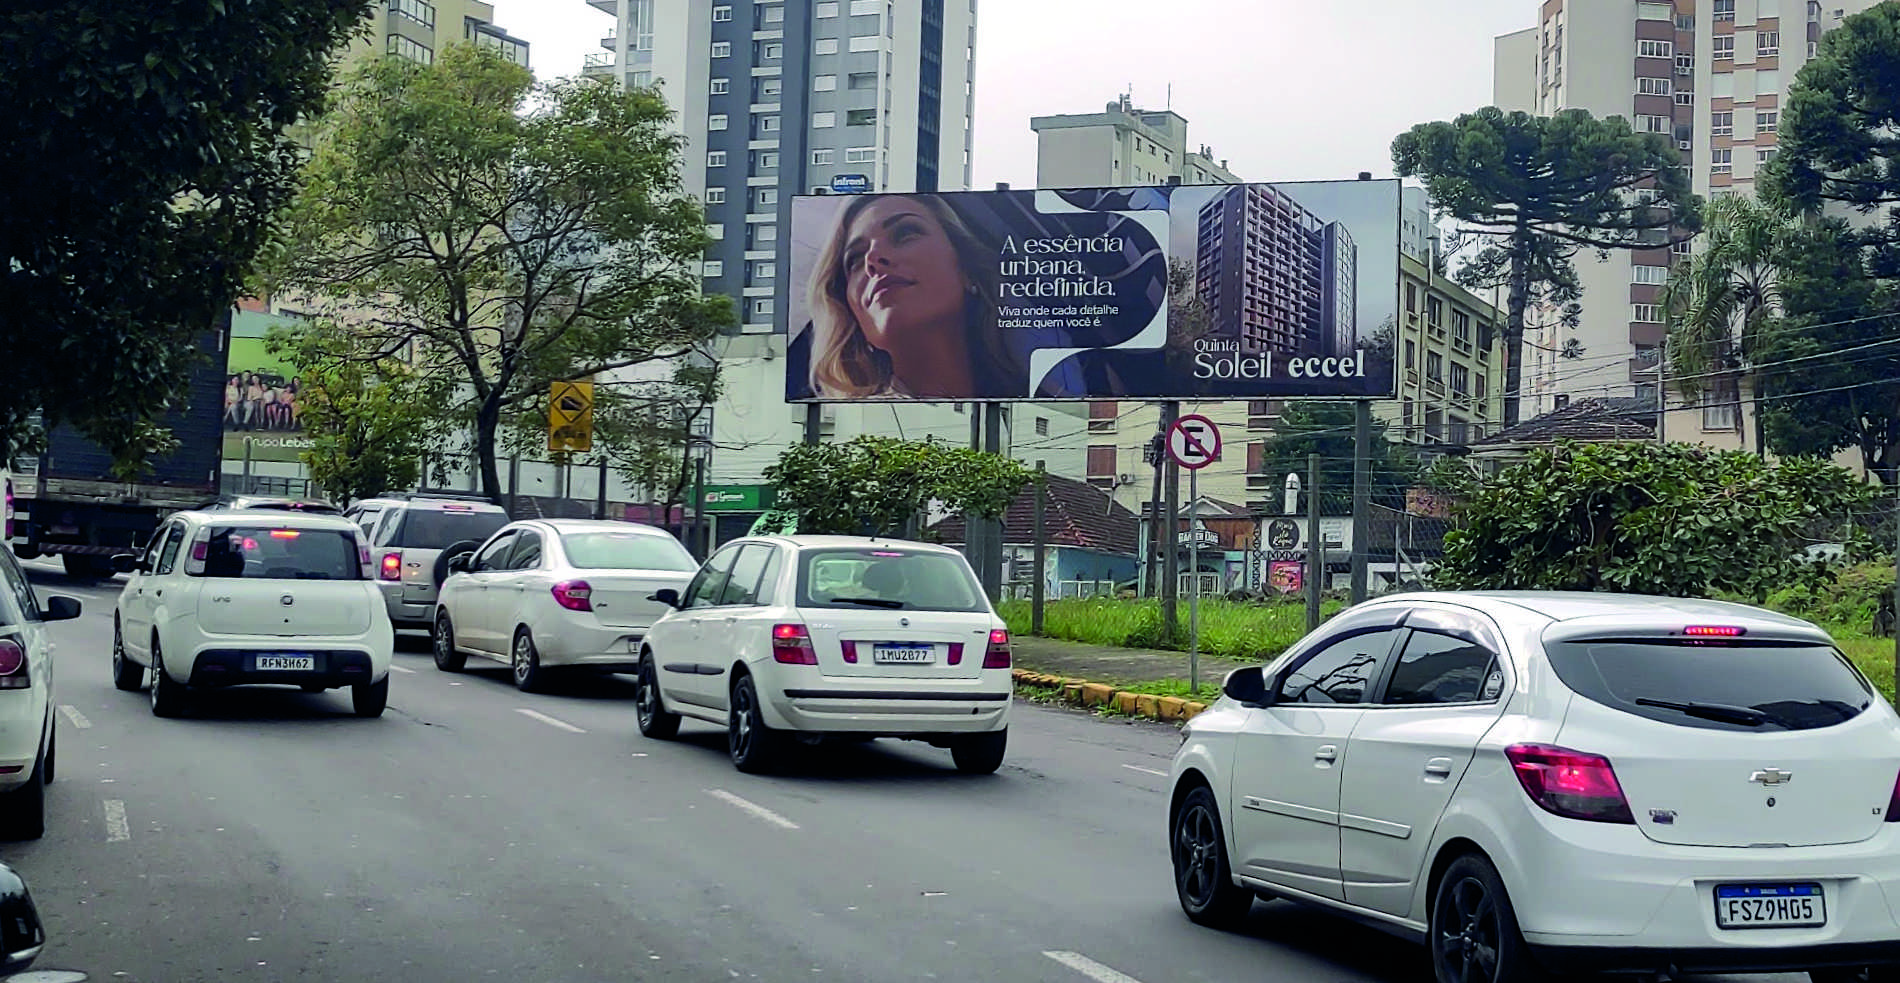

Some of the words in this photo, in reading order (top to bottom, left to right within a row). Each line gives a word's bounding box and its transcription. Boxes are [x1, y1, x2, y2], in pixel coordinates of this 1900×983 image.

[1001, 234, 1017, 254] A
[1023, 233, 1124, 254] essência
[1000, 276, 1116, 297] redefinida.
[998, 306, 1020, 316] Viva
[1022, 305, 1050, 316] onde
[1051, 305, 1078, 316] cada
[1079, 304, 1119, 316] detalhe
[998, 318, 1032, 328] traduz
[1033, 319, 1064, 329] quem
[1065, 317, 1091, 328] você
[1193, 338, 1240, 352] Quinta
[1193, 351, 1272, 379] Soleil
[1288, 349, 1366, 378] eccel
[1184, 426, 1204, 457] E
[1728, 898, 1813, 922] FSZ9H05
